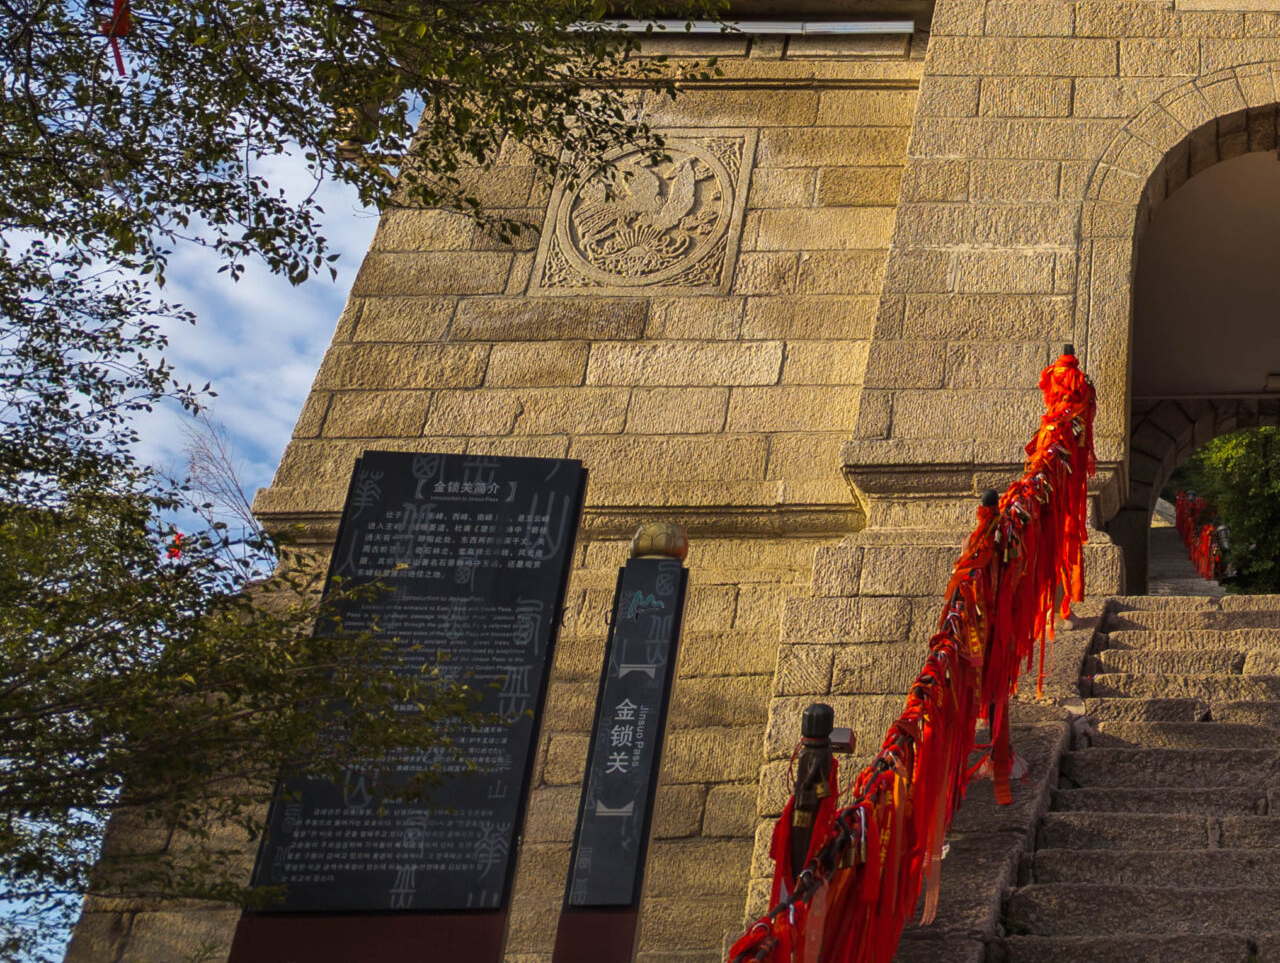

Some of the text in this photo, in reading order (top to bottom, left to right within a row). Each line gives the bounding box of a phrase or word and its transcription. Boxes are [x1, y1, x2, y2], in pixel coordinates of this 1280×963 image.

[433, 480, 500, 494] 金锁关简介
[605, 698, 638, 774] 金锁关
[631, 704, 649, 767] Jinsuo Pass
